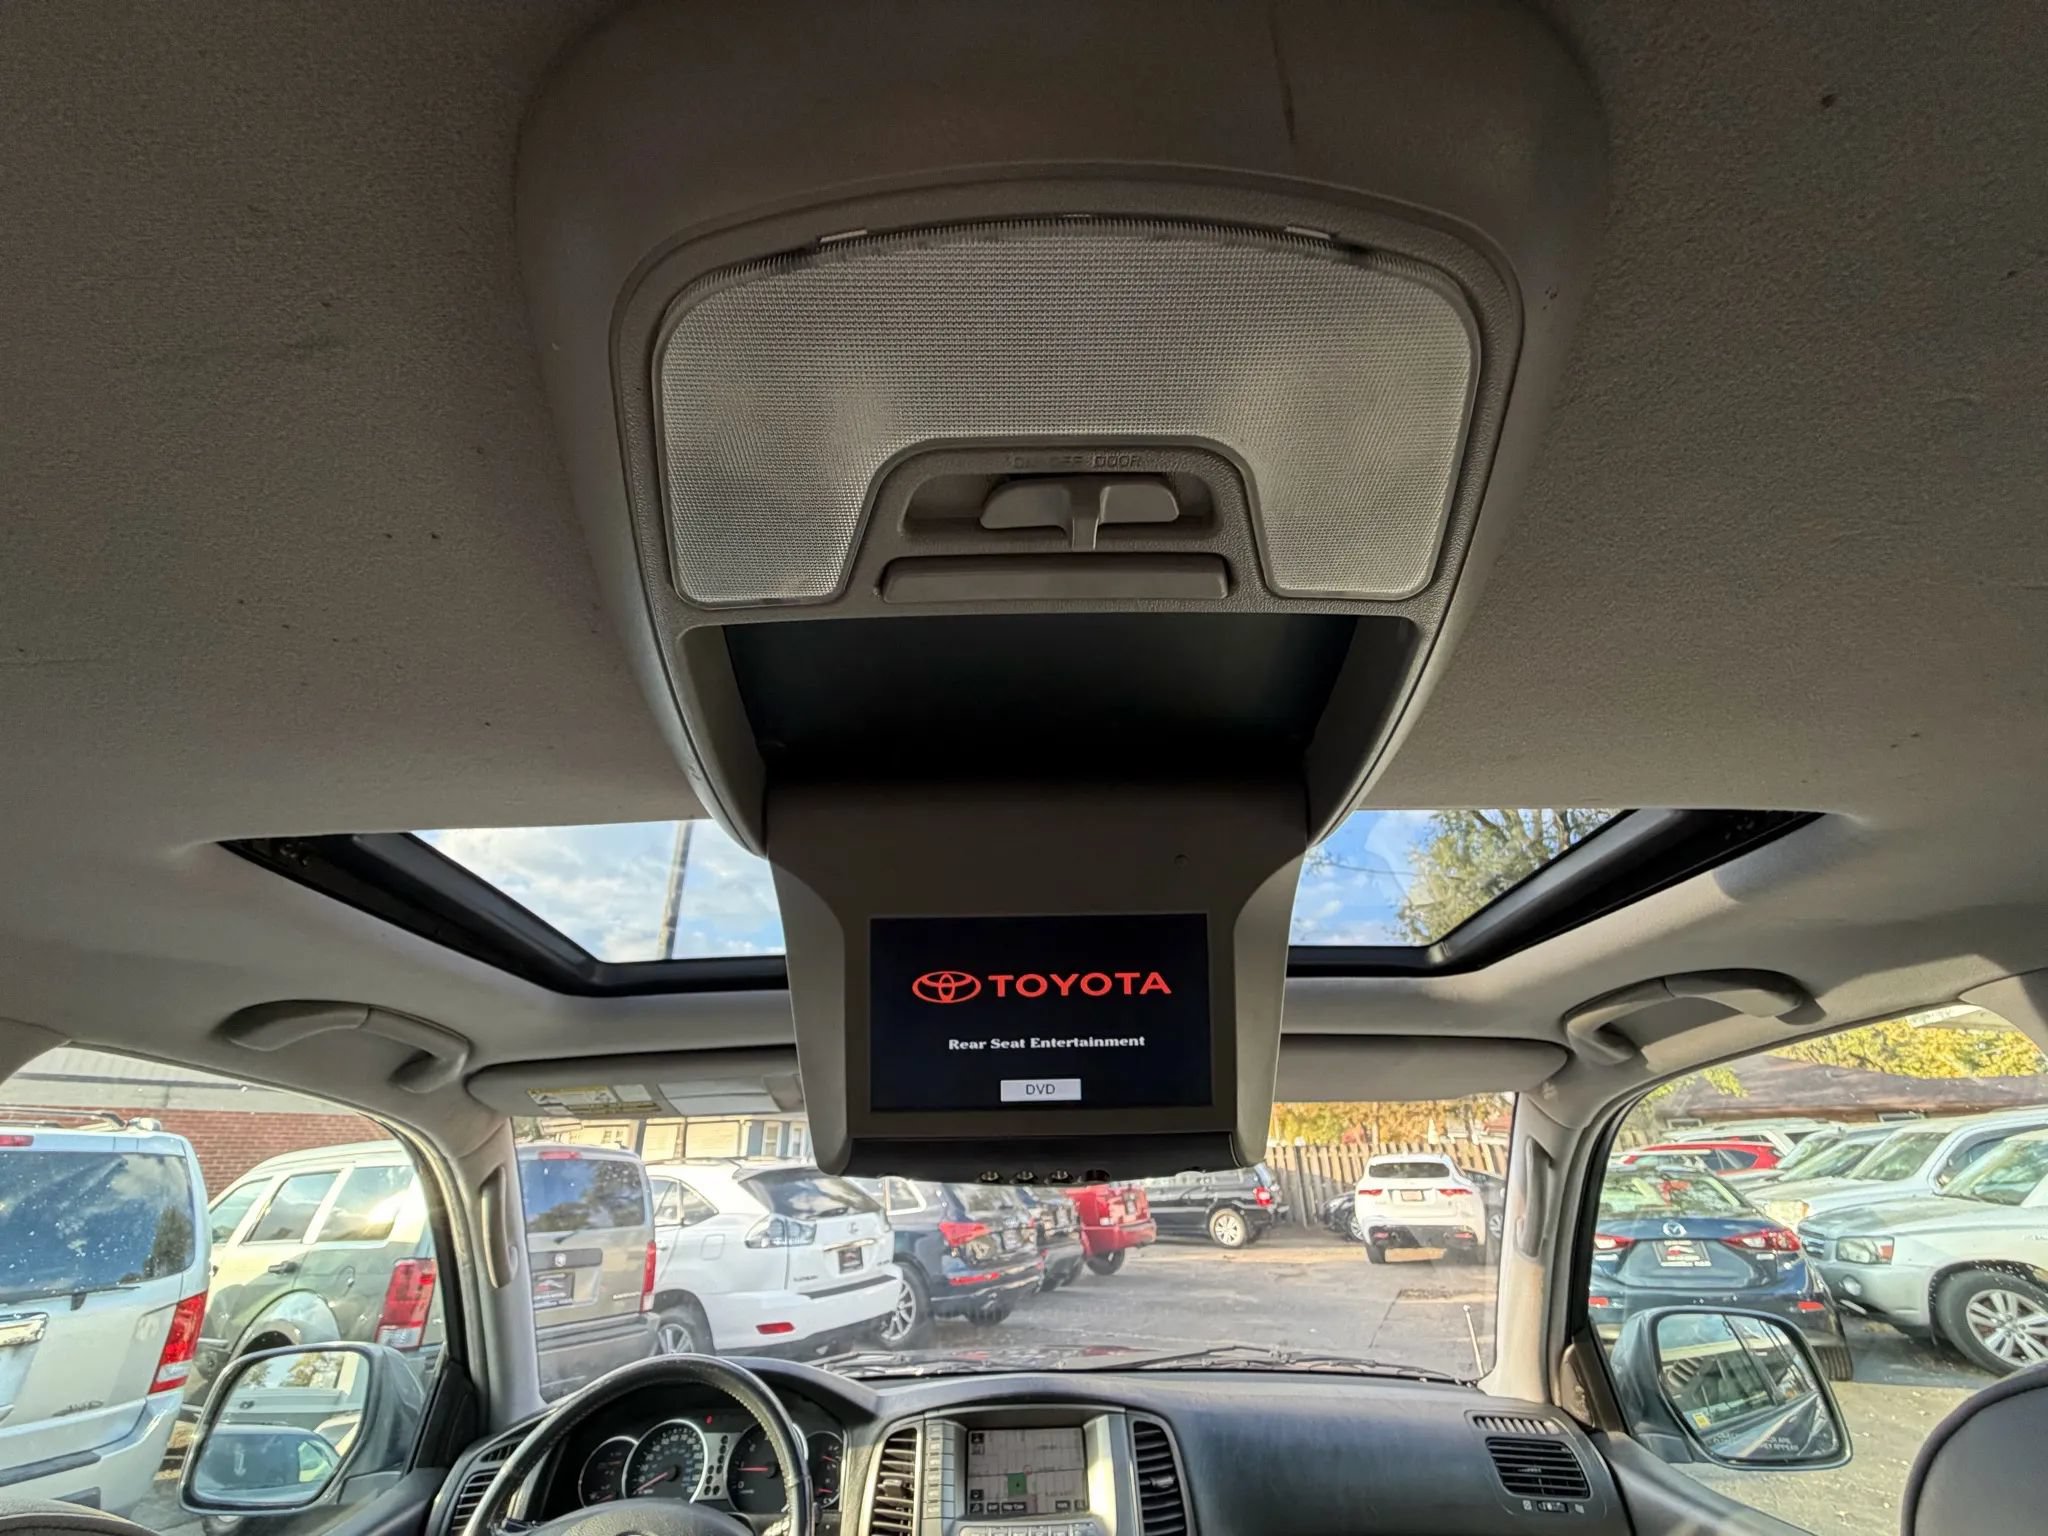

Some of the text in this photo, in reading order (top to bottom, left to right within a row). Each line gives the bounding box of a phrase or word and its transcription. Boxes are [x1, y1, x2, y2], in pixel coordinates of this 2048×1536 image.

[988, 972, 1172, 998] TOYOTA
[949, 1036, 1146, 1050] Rear Seat Entertainment
[1025, 1083, 1056, 1096] DVD
